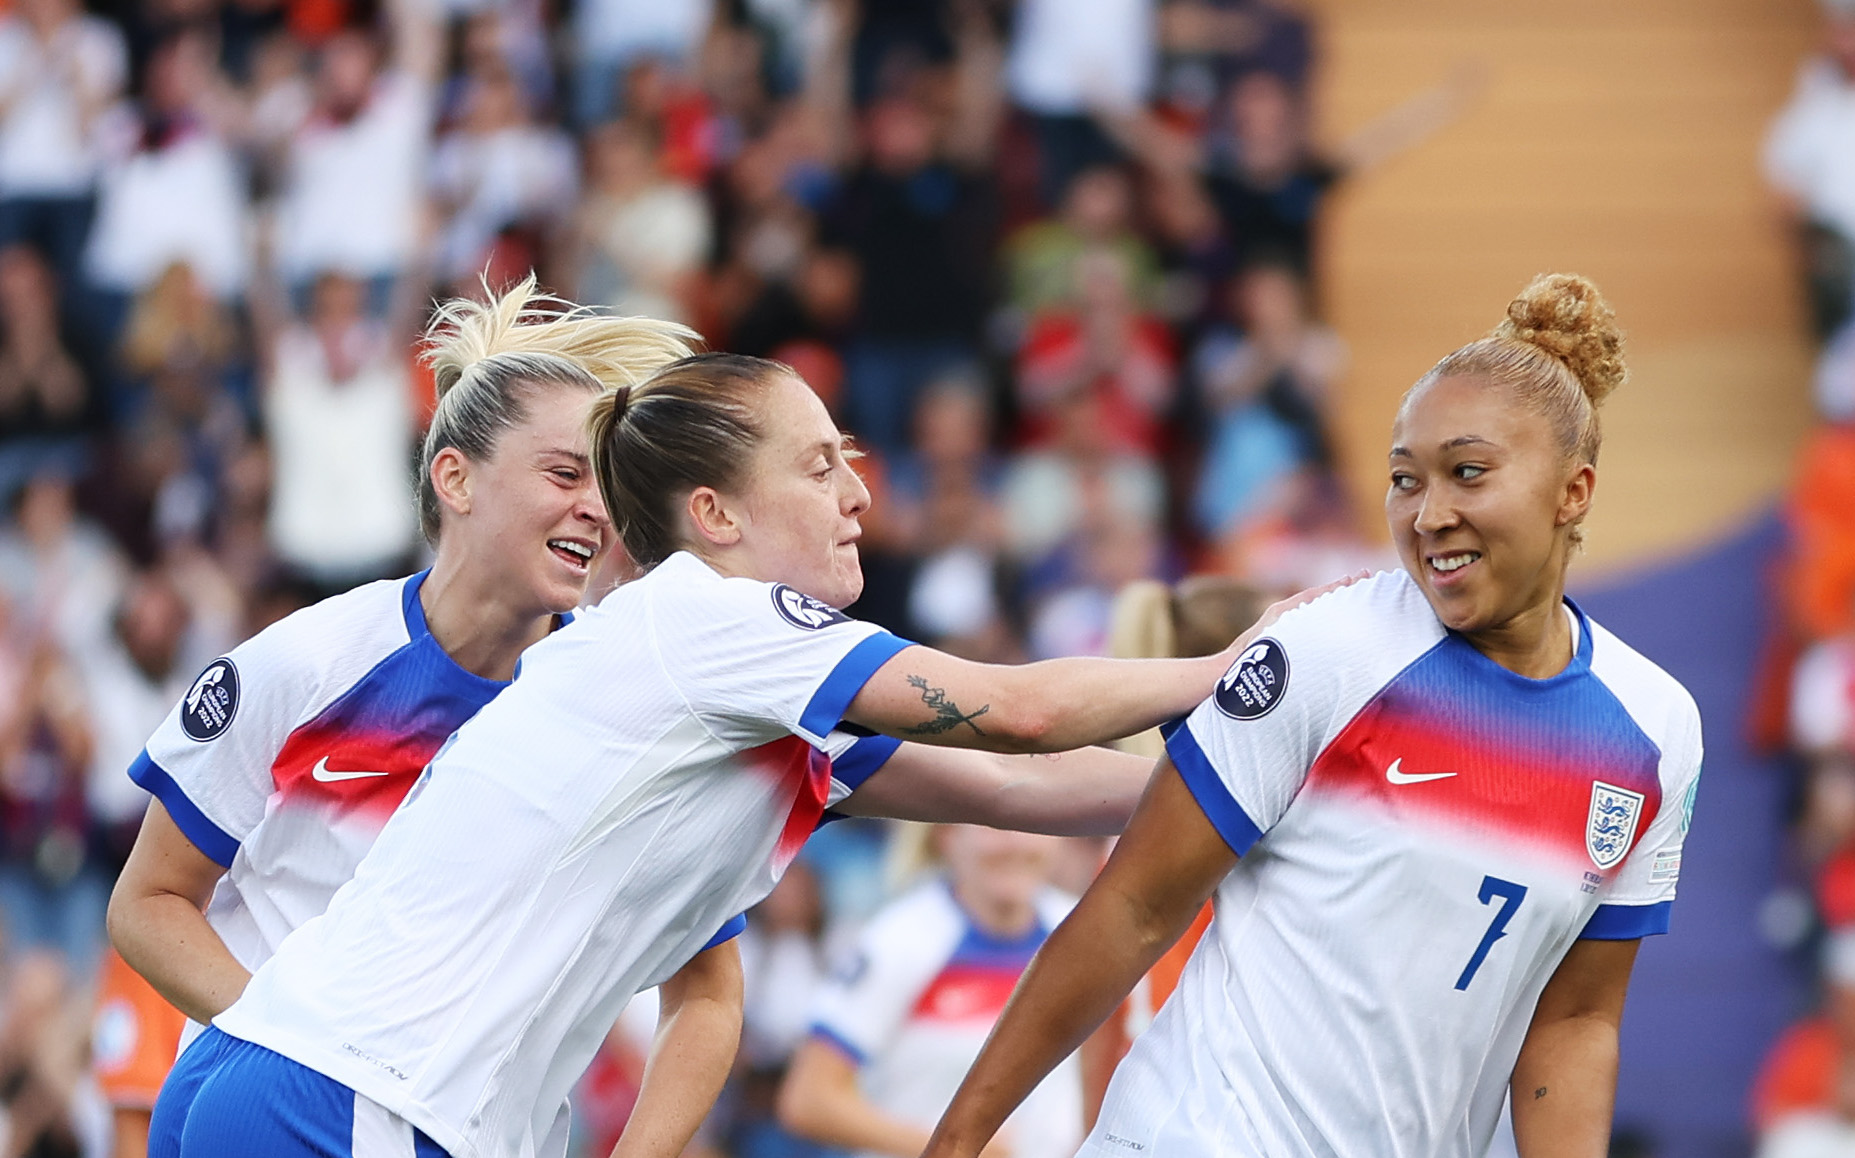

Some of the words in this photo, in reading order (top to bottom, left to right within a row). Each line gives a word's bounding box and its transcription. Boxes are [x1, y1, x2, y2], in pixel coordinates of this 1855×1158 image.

[1235, 683, 1254, 707] 2022
[1240, 671, 1267, 707] CHAMPIONS
[1247, 667, 1272, 700] EUROPEAN
[198, 707, 213, 729] 2022
[1454, 875, 1529, 991] 7
